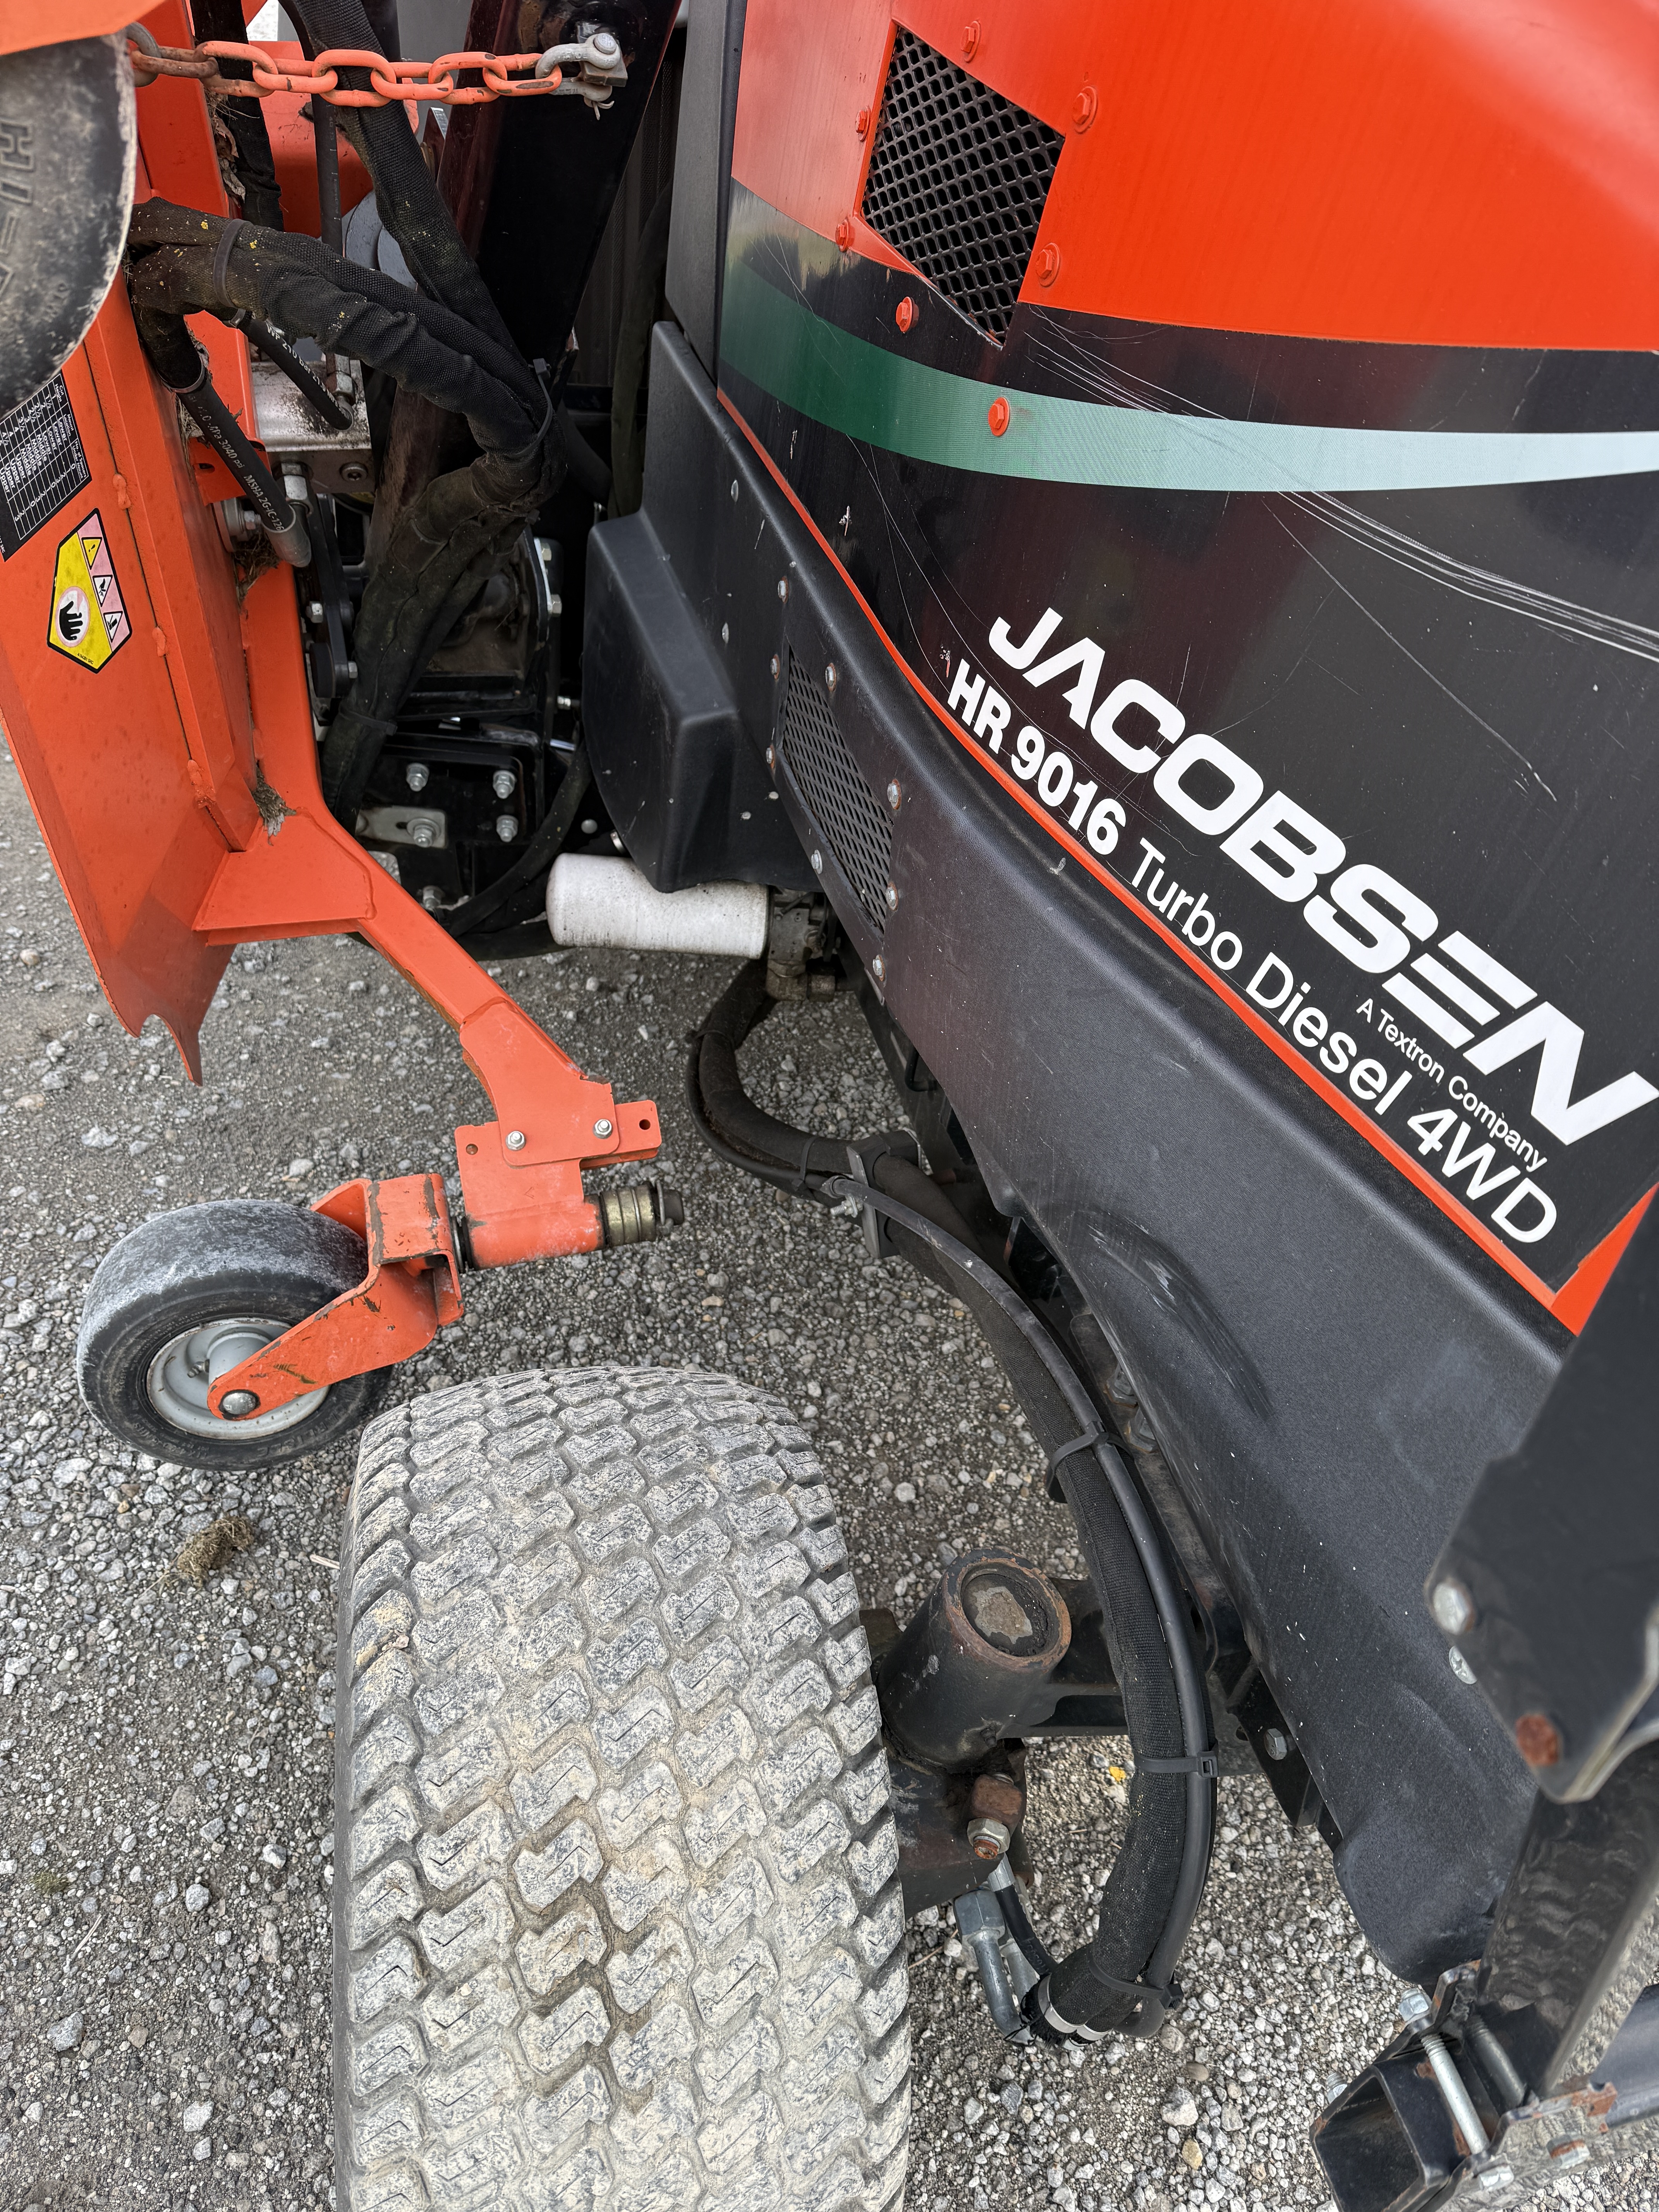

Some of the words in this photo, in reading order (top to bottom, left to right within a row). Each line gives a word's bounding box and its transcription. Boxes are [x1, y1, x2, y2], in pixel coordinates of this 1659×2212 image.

[266, 321, 280, 339] WP
[282, 339, 297, 359] 210
[299, 356, 311, 374] bar
[42, 430, 52, 454] Lower
[47, 426, 57, 450] Lower
[53, 421, 62, 445] Lower
[58, 417, 67, 440] Lower
[21, 447, 33, 475] Middle
[26, 443, 36, 471] Middle
[31, 438, 41, 466] Middle
[36, 434, 47, 461] Middle
[5, 462, 15, 488] Upper
[10, 458, 21, 483] Upper
[16, 453, 26, 478] Upper
[218, 440, 237, 459] 3040
[233, 459, 245, 469] psi
[244, 475, 264, 498] MSHA
[0, 467, 10, 492] Upper
[988, 607, 1659, 1146] JACOBSEN
[947, 658, 1011, 754] HR
[1011, 725, 1126, 855] 9016
[1131, 837, 1242, 970] Turbo
[1245, 952, 1412, 1115] Diesel
[1407, 1108, 1557, 1243] 4WD
[1356, 998, 1374, 1024] A
[1376, 1009, 1445, 1084] Textron
[1448, 1075, 1547, 1173] Company
[255, 1405, 351, 1458] CARLISLE
